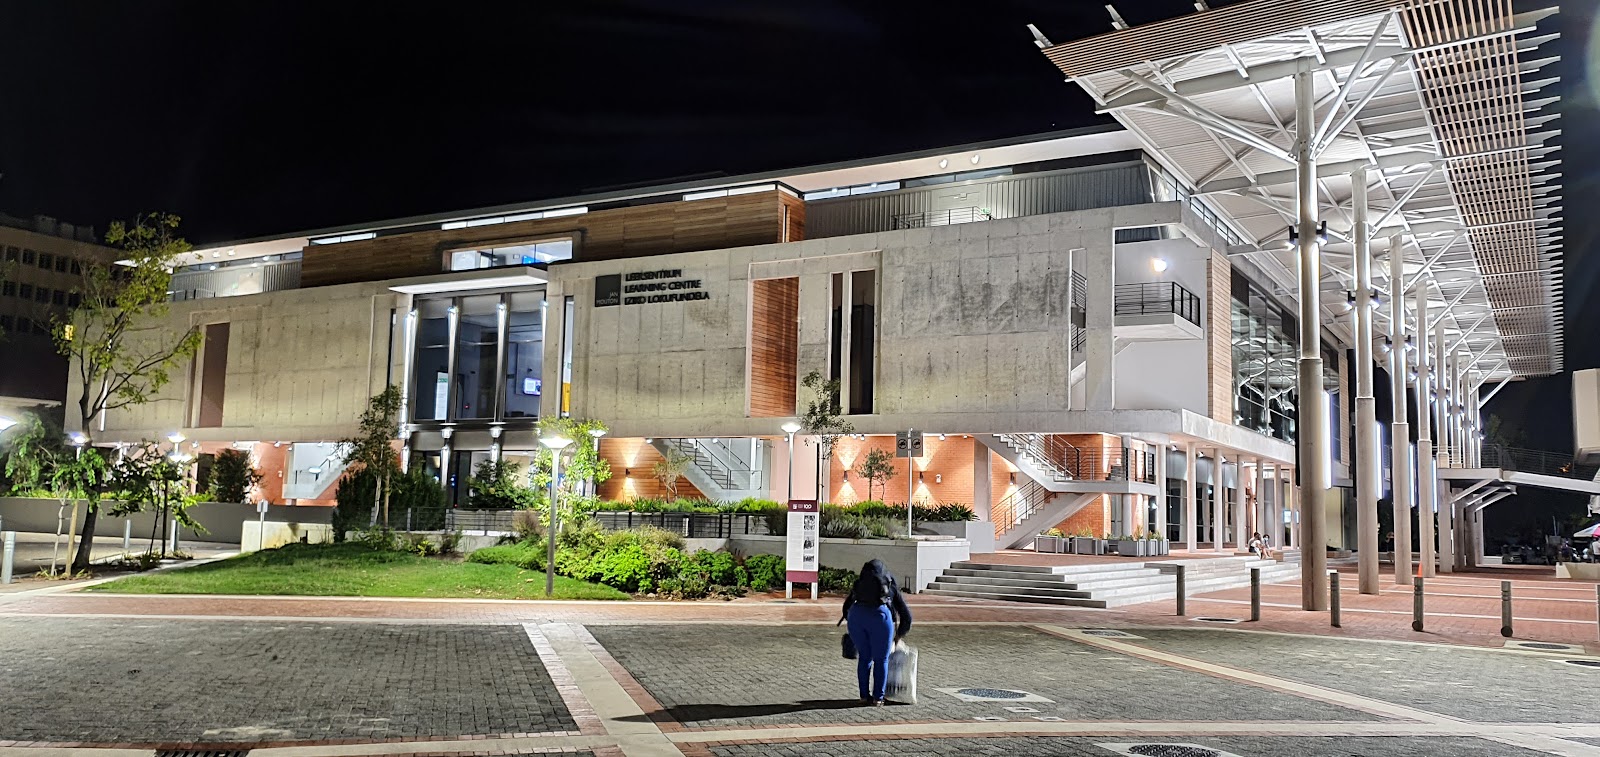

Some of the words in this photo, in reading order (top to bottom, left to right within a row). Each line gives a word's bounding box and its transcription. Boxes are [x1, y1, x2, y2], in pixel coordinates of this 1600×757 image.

[625, 269, 682, 281] LEERSENTRUM
[624, 282, 667, 293] LEARNING
[668, 279, 701, 290] CENTRE
